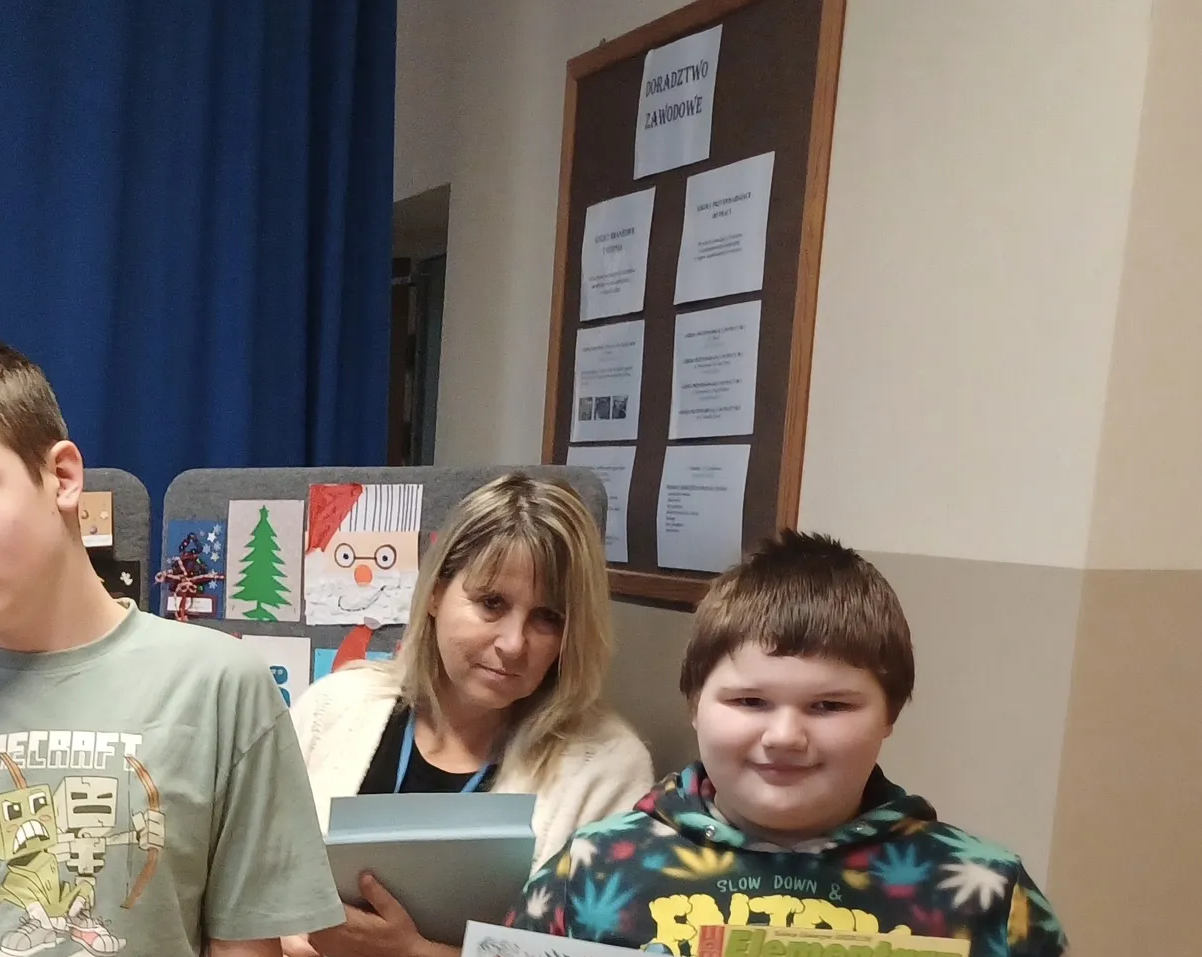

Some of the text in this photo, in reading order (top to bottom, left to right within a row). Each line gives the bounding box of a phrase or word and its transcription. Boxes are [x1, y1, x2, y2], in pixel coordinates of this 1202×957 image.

[645, 59, 709, 98] DORADZTWO
[644, 96, 703, 130] ZAWODOWE
[716, 875, 843, 903] SLOW DOWN &
